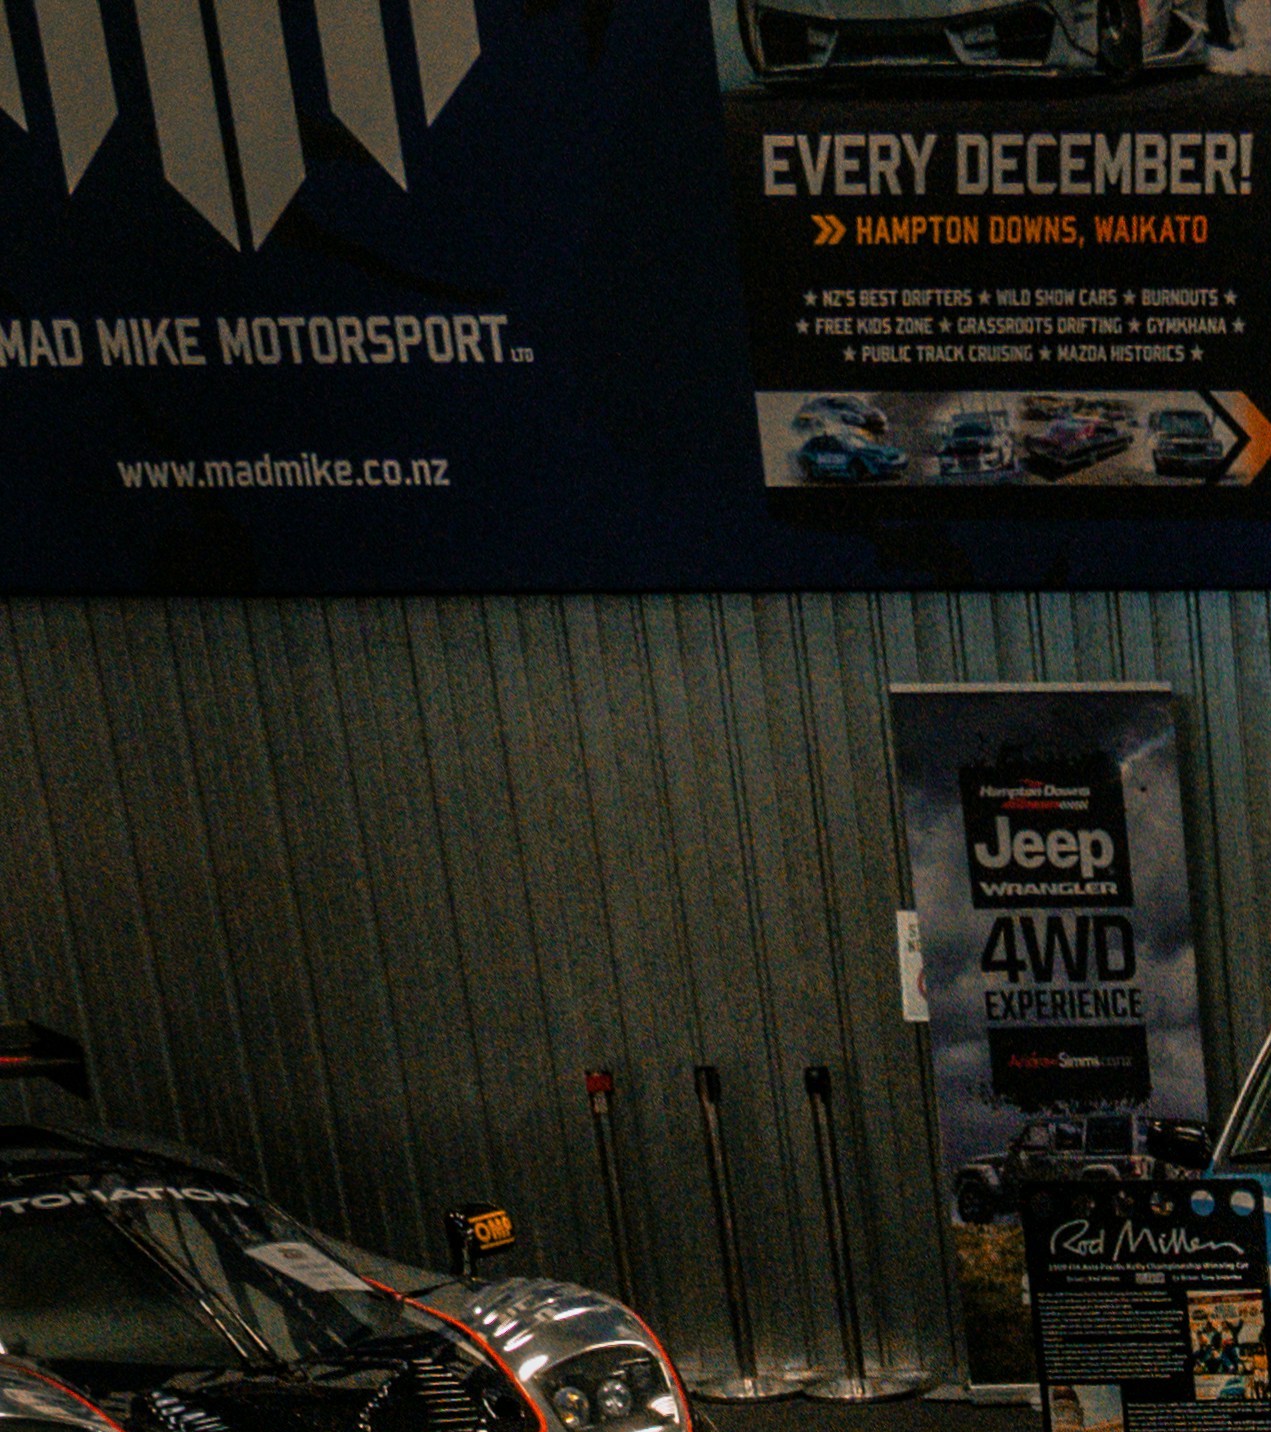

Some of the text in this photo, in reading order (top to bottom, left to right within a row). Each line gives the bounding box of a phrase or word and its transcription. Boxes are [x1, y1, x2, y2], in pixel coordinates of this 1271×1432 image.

[762, 133, 1254, 196] EVERY DECEMBER!
[856, 215, 1209, 248] HAMPTON DOWNS, WAIKATO
[0, 318, 83, 367] MAD
[96, 317, 207, 366] MIKE
[217, 315, 508, 365] MOTORSPORT
[117, 453, 450, 488] www.madmike.co.nz
[973, 815, 1115, 880] Jeep
[979, 880, 1120, 898] WRANGLER
[980, 914, 1137, 985] 4WD
[985, 988, 1142, 1022] EXPERIENCE
[475, 1217, 512, 1241] OMP
[1049, 1219, 1245, 1261] Rod Millen
